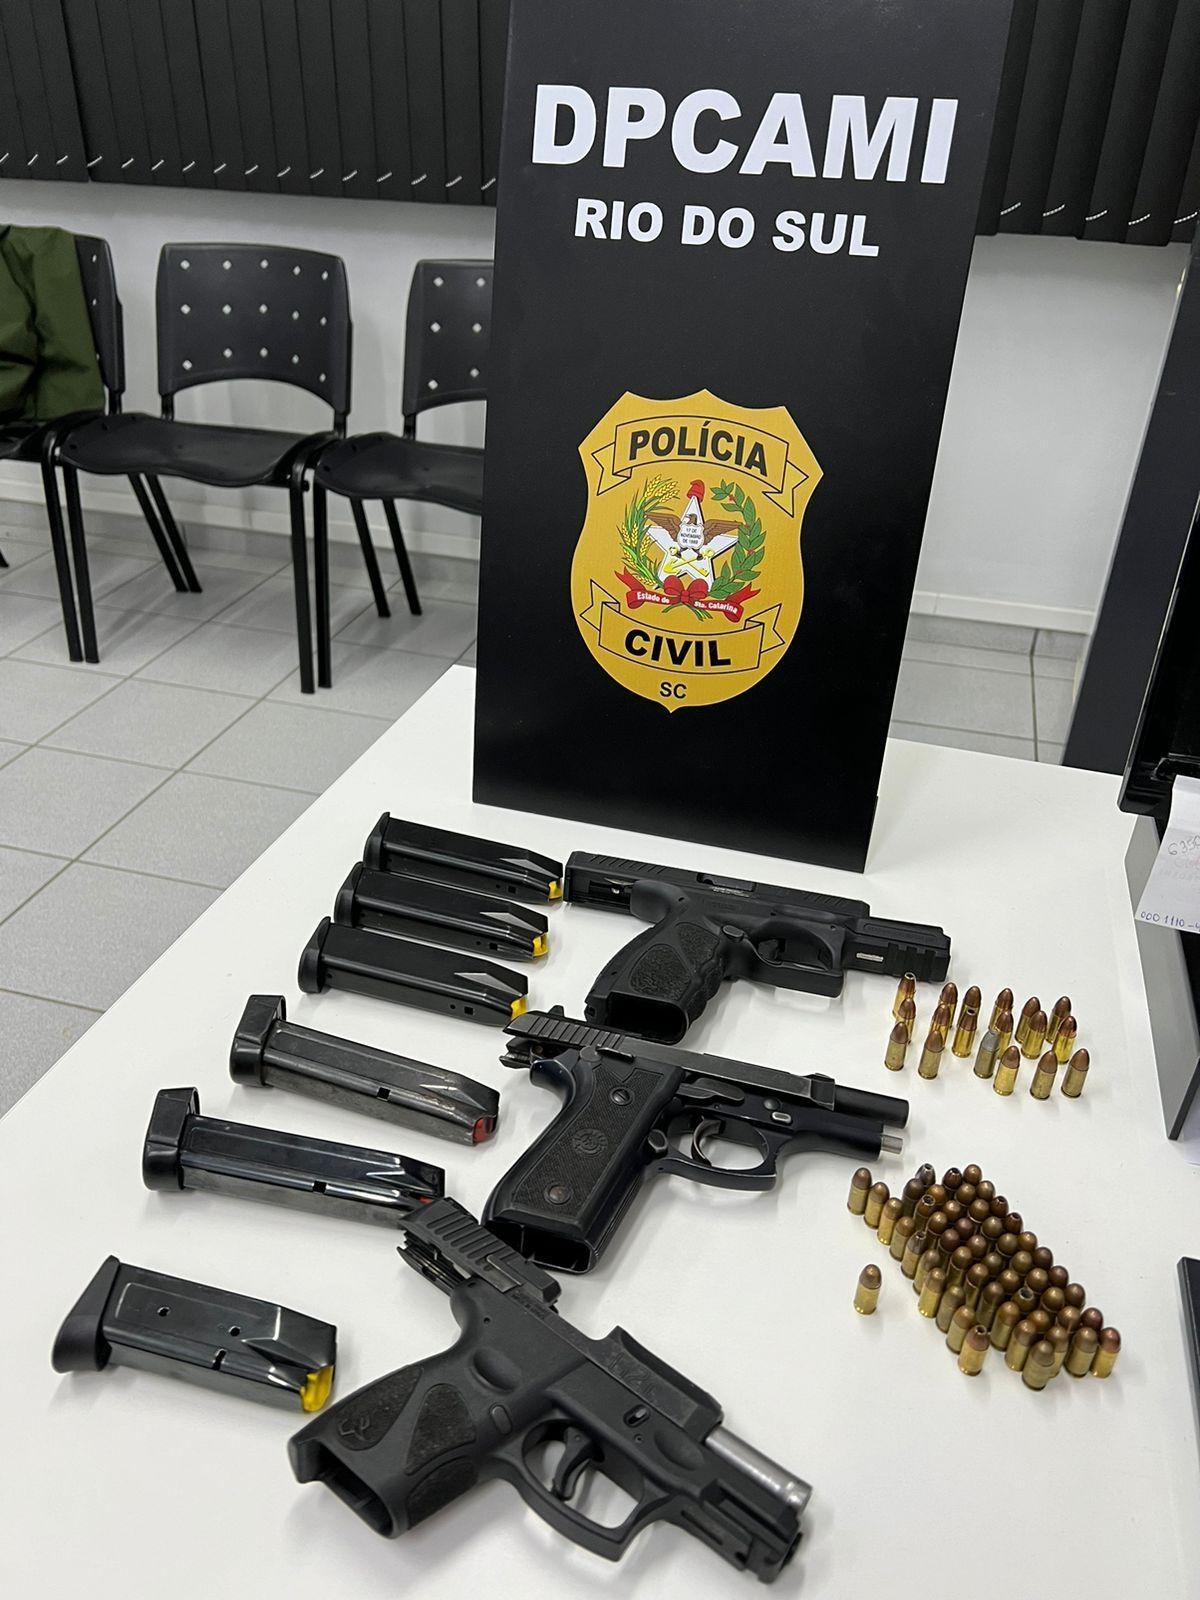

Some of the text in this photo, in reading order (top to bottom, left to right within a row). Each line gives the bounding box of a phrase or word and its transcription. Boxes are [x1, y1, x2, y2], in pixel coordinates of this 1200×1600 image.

[532, 84, 959, 184] DPCAMI
[574, 198, 880, 257] RIO DO SUL
[629, 420, 767, 477] POLÍCIA
[637, 591, 660, 602] Estado
[661, 596, 670, 604] de
[708, 601, 738, 614] Catarina
[625, 629, 731, 667] CIVIL
[660, 681, 687, 699] SC
